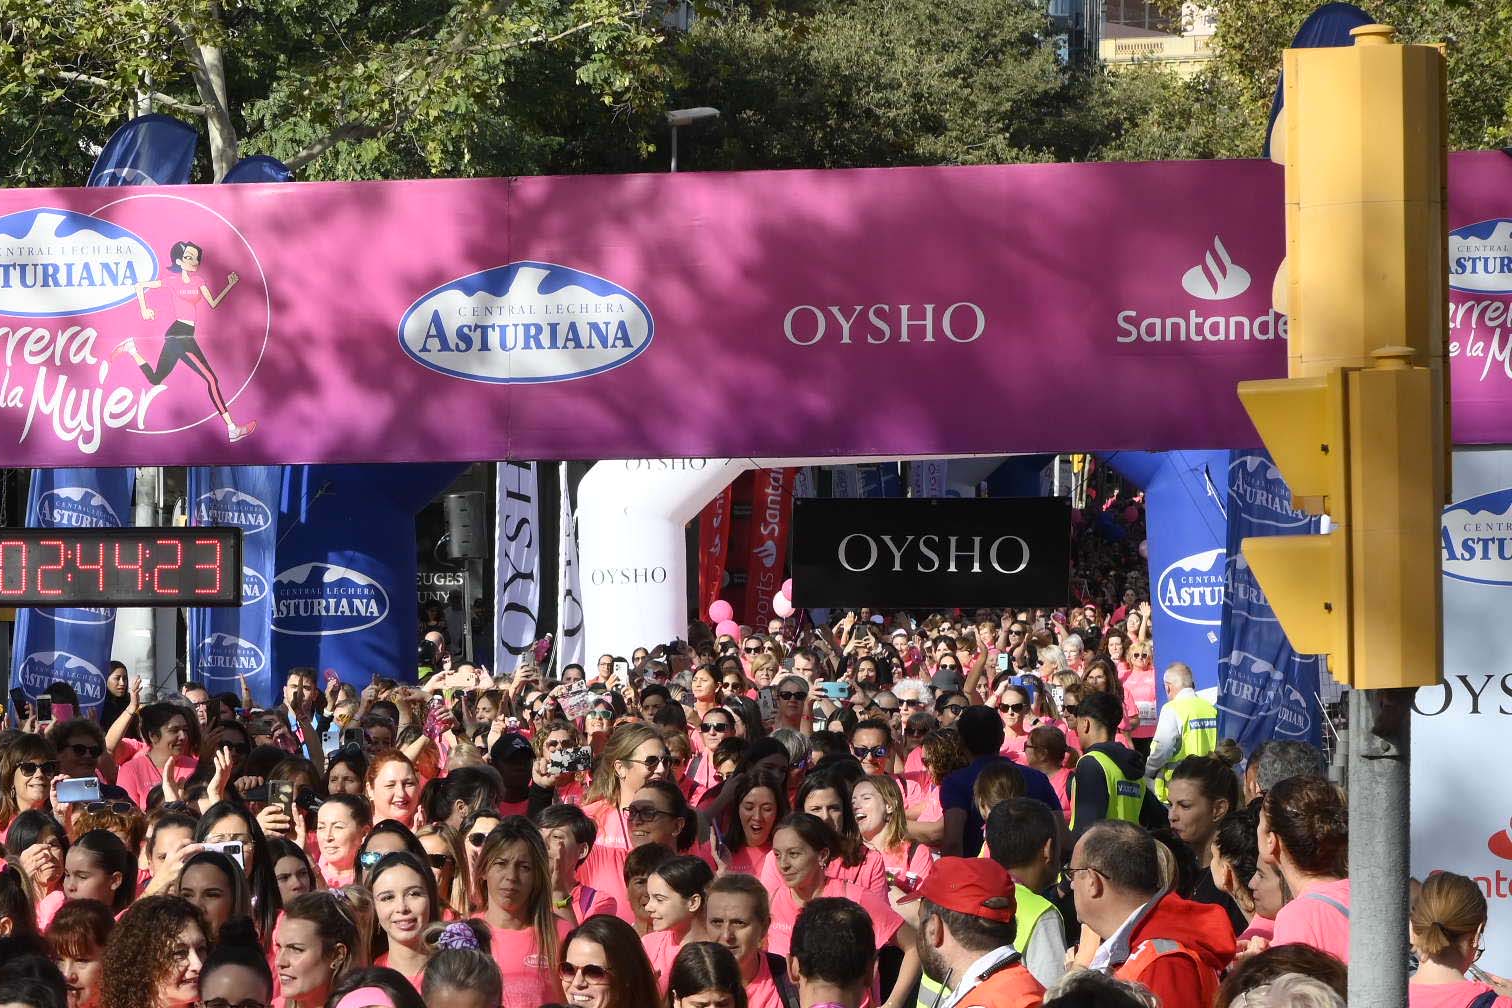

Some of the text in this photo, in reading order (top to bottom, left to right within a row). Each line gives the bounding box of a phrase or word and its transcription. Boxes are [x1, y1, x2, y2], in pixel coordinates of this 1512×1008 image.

[60, 244, 134, 257] LECHERA
[457, 301, 626, 318] CENTRAL LECHERA
[783, 302, 986, 346] OYSHO
[418, 307, 635, 354] ASTURIANA
[1466, 329, 1485, 358] la
[0, 367, 24, 410] la
[18, 360, 168, 454] Mujer
[838, 533, 1030, 574] OYSHO
[590, 566, 667, 586] OYSHO
[326, 587, 376, 596] LECHERA
[1164, 577, 1225, 607] ASTU
[271, 598, 380, 619] ASTURIANA
